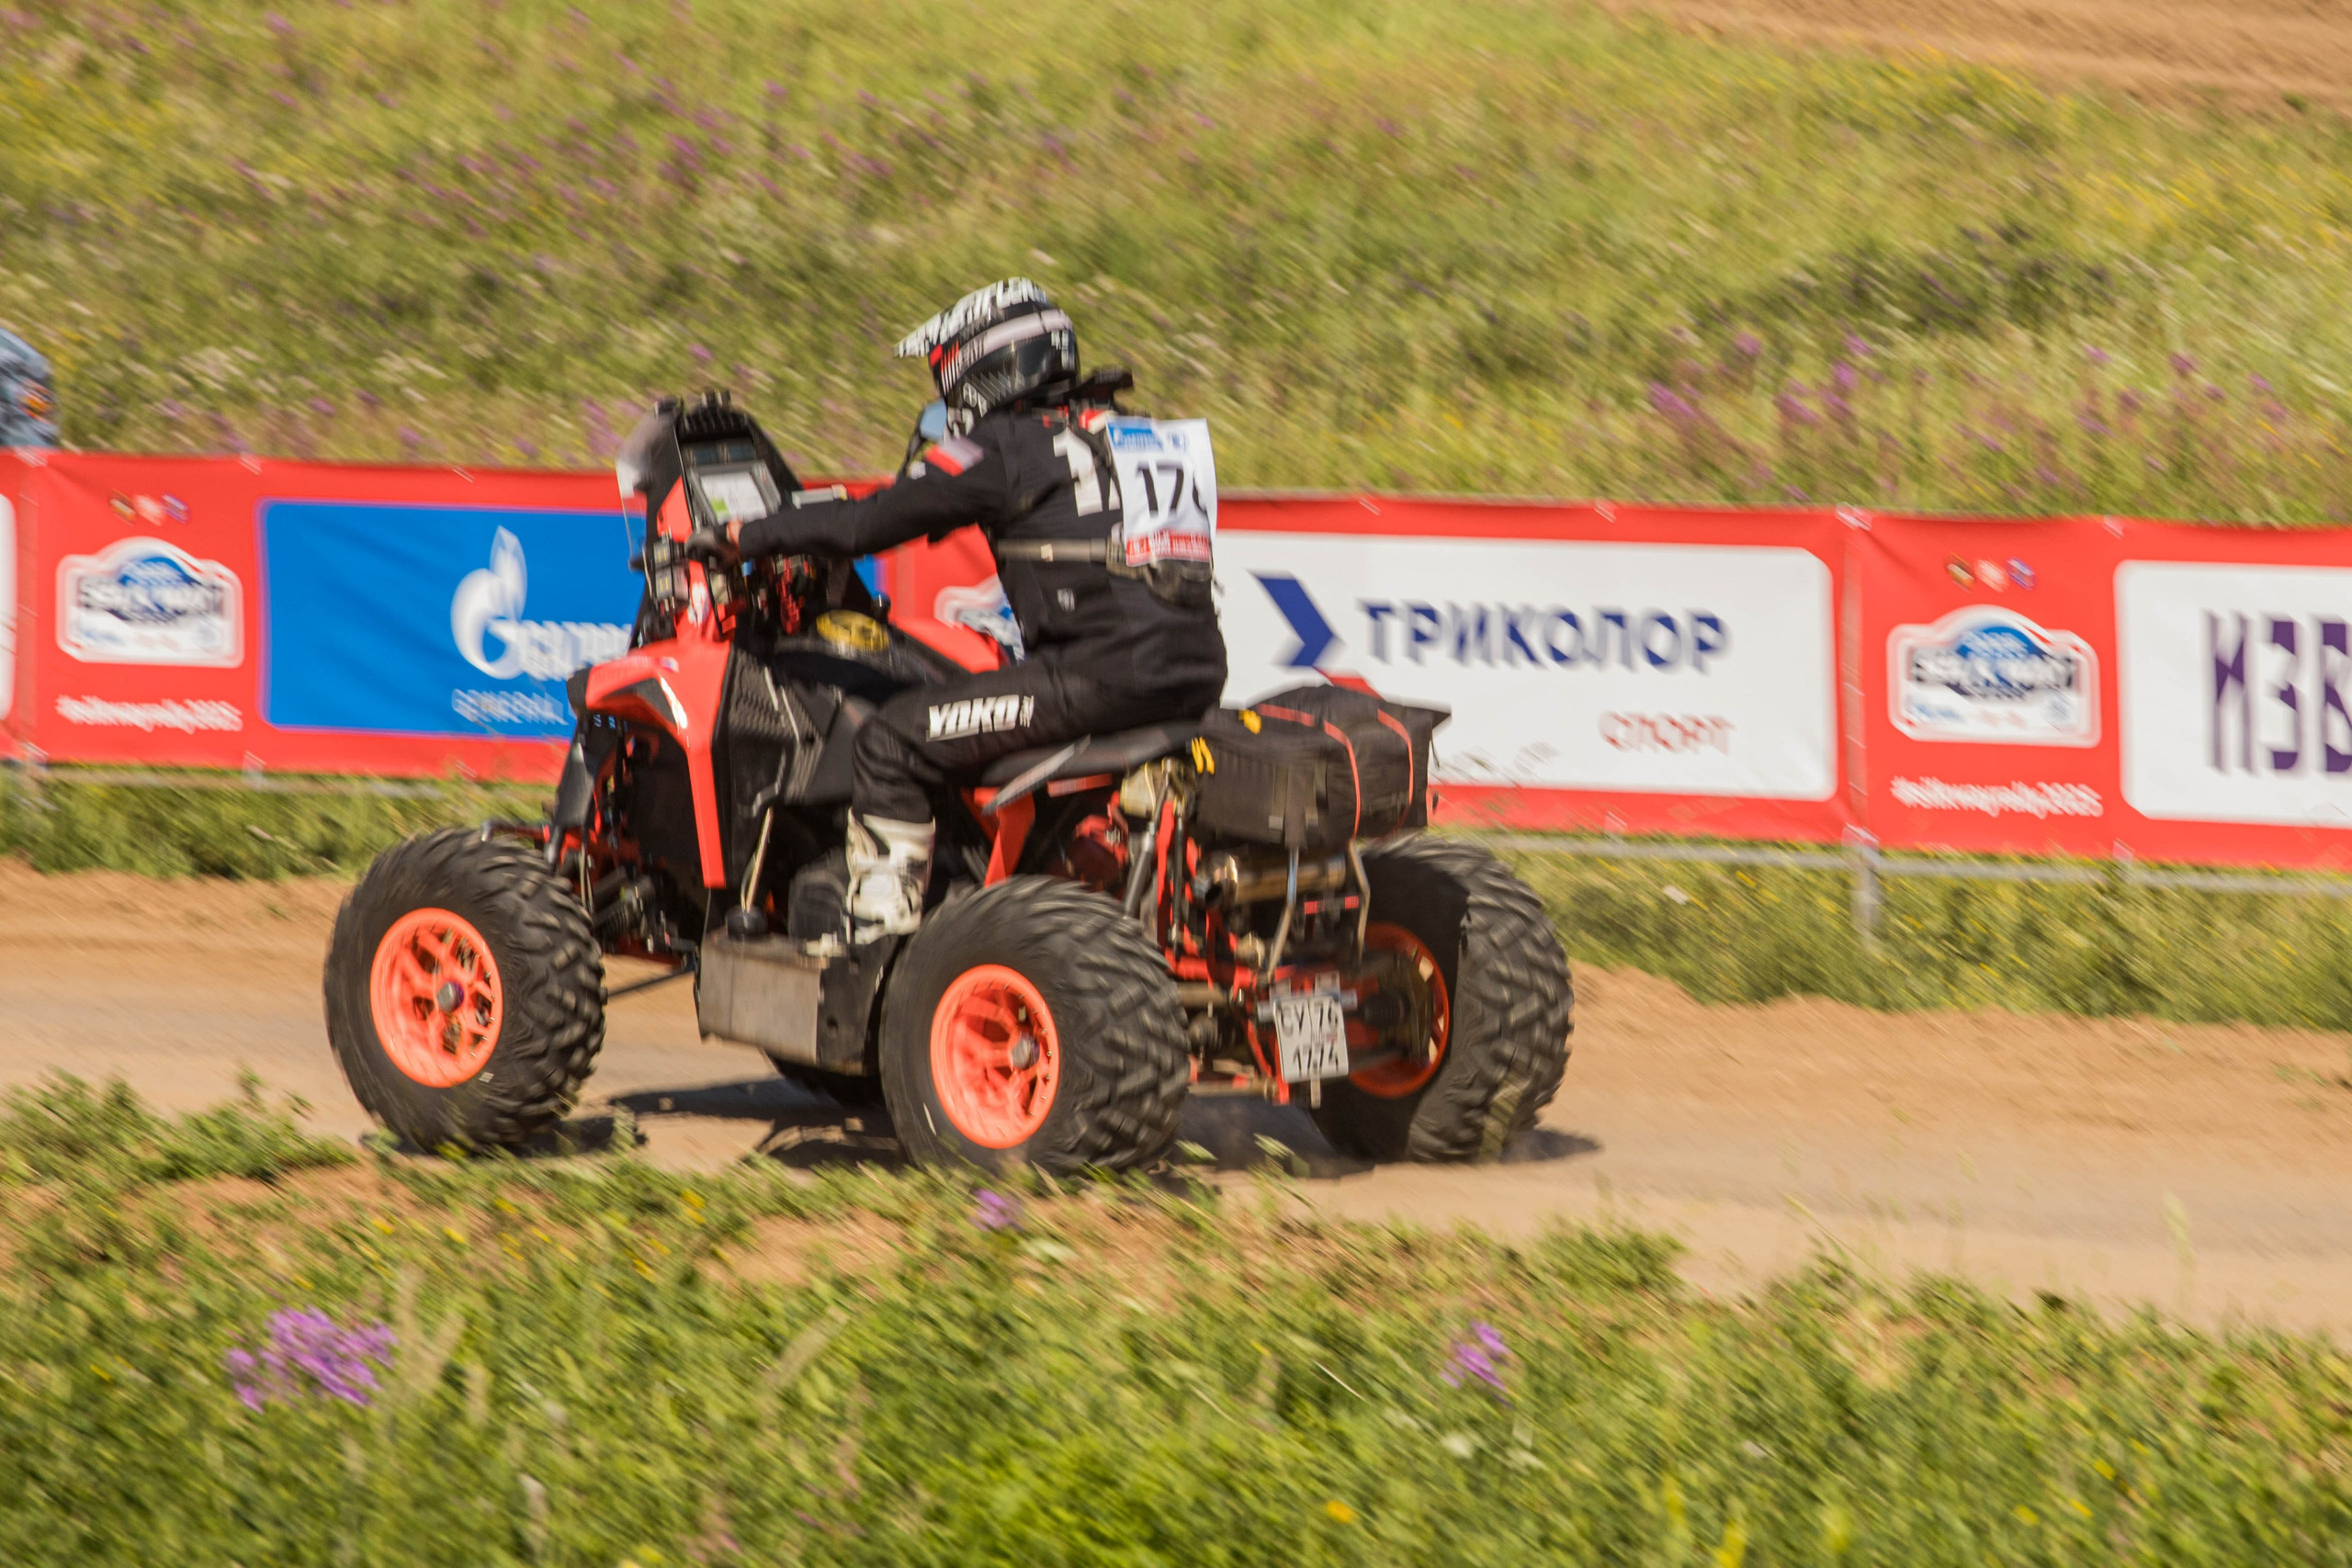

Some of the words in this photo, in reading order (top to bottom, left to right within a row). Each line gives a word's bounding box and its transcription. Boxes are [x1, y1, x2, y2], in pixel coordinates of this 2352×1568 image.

[1358, 600, 1730, 674] ТРИКОЛОР
[929, 694, 1020, 738] YOKO
[1599, 712, 1734, 755] СПОРТ
